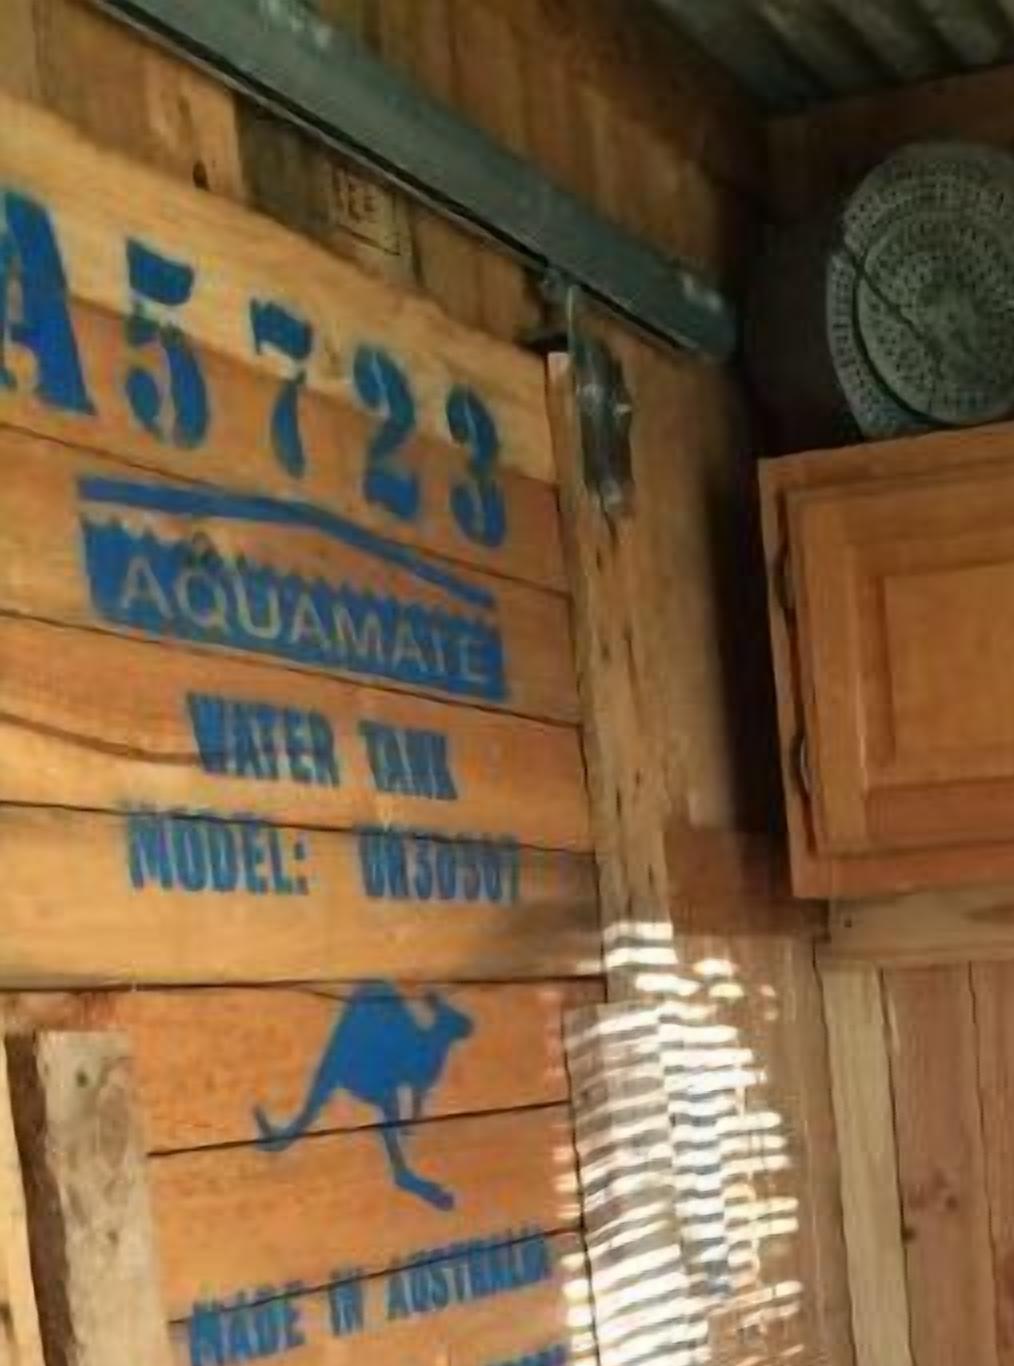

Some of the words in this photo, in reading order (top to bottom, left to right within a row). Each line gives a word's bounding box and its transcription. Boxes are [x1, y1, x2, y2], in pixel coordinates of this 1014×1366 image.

[116, 550, 492, 688] AQUAMATE
[186, 692, 340, 788] WATER
[360, 720, 456, 800] TANK
[126, 800, 310, 895] MODEL:
[328, 1266, 364, 1336] IN
[384, 1225, 552, 1322] AUSTRALIA
